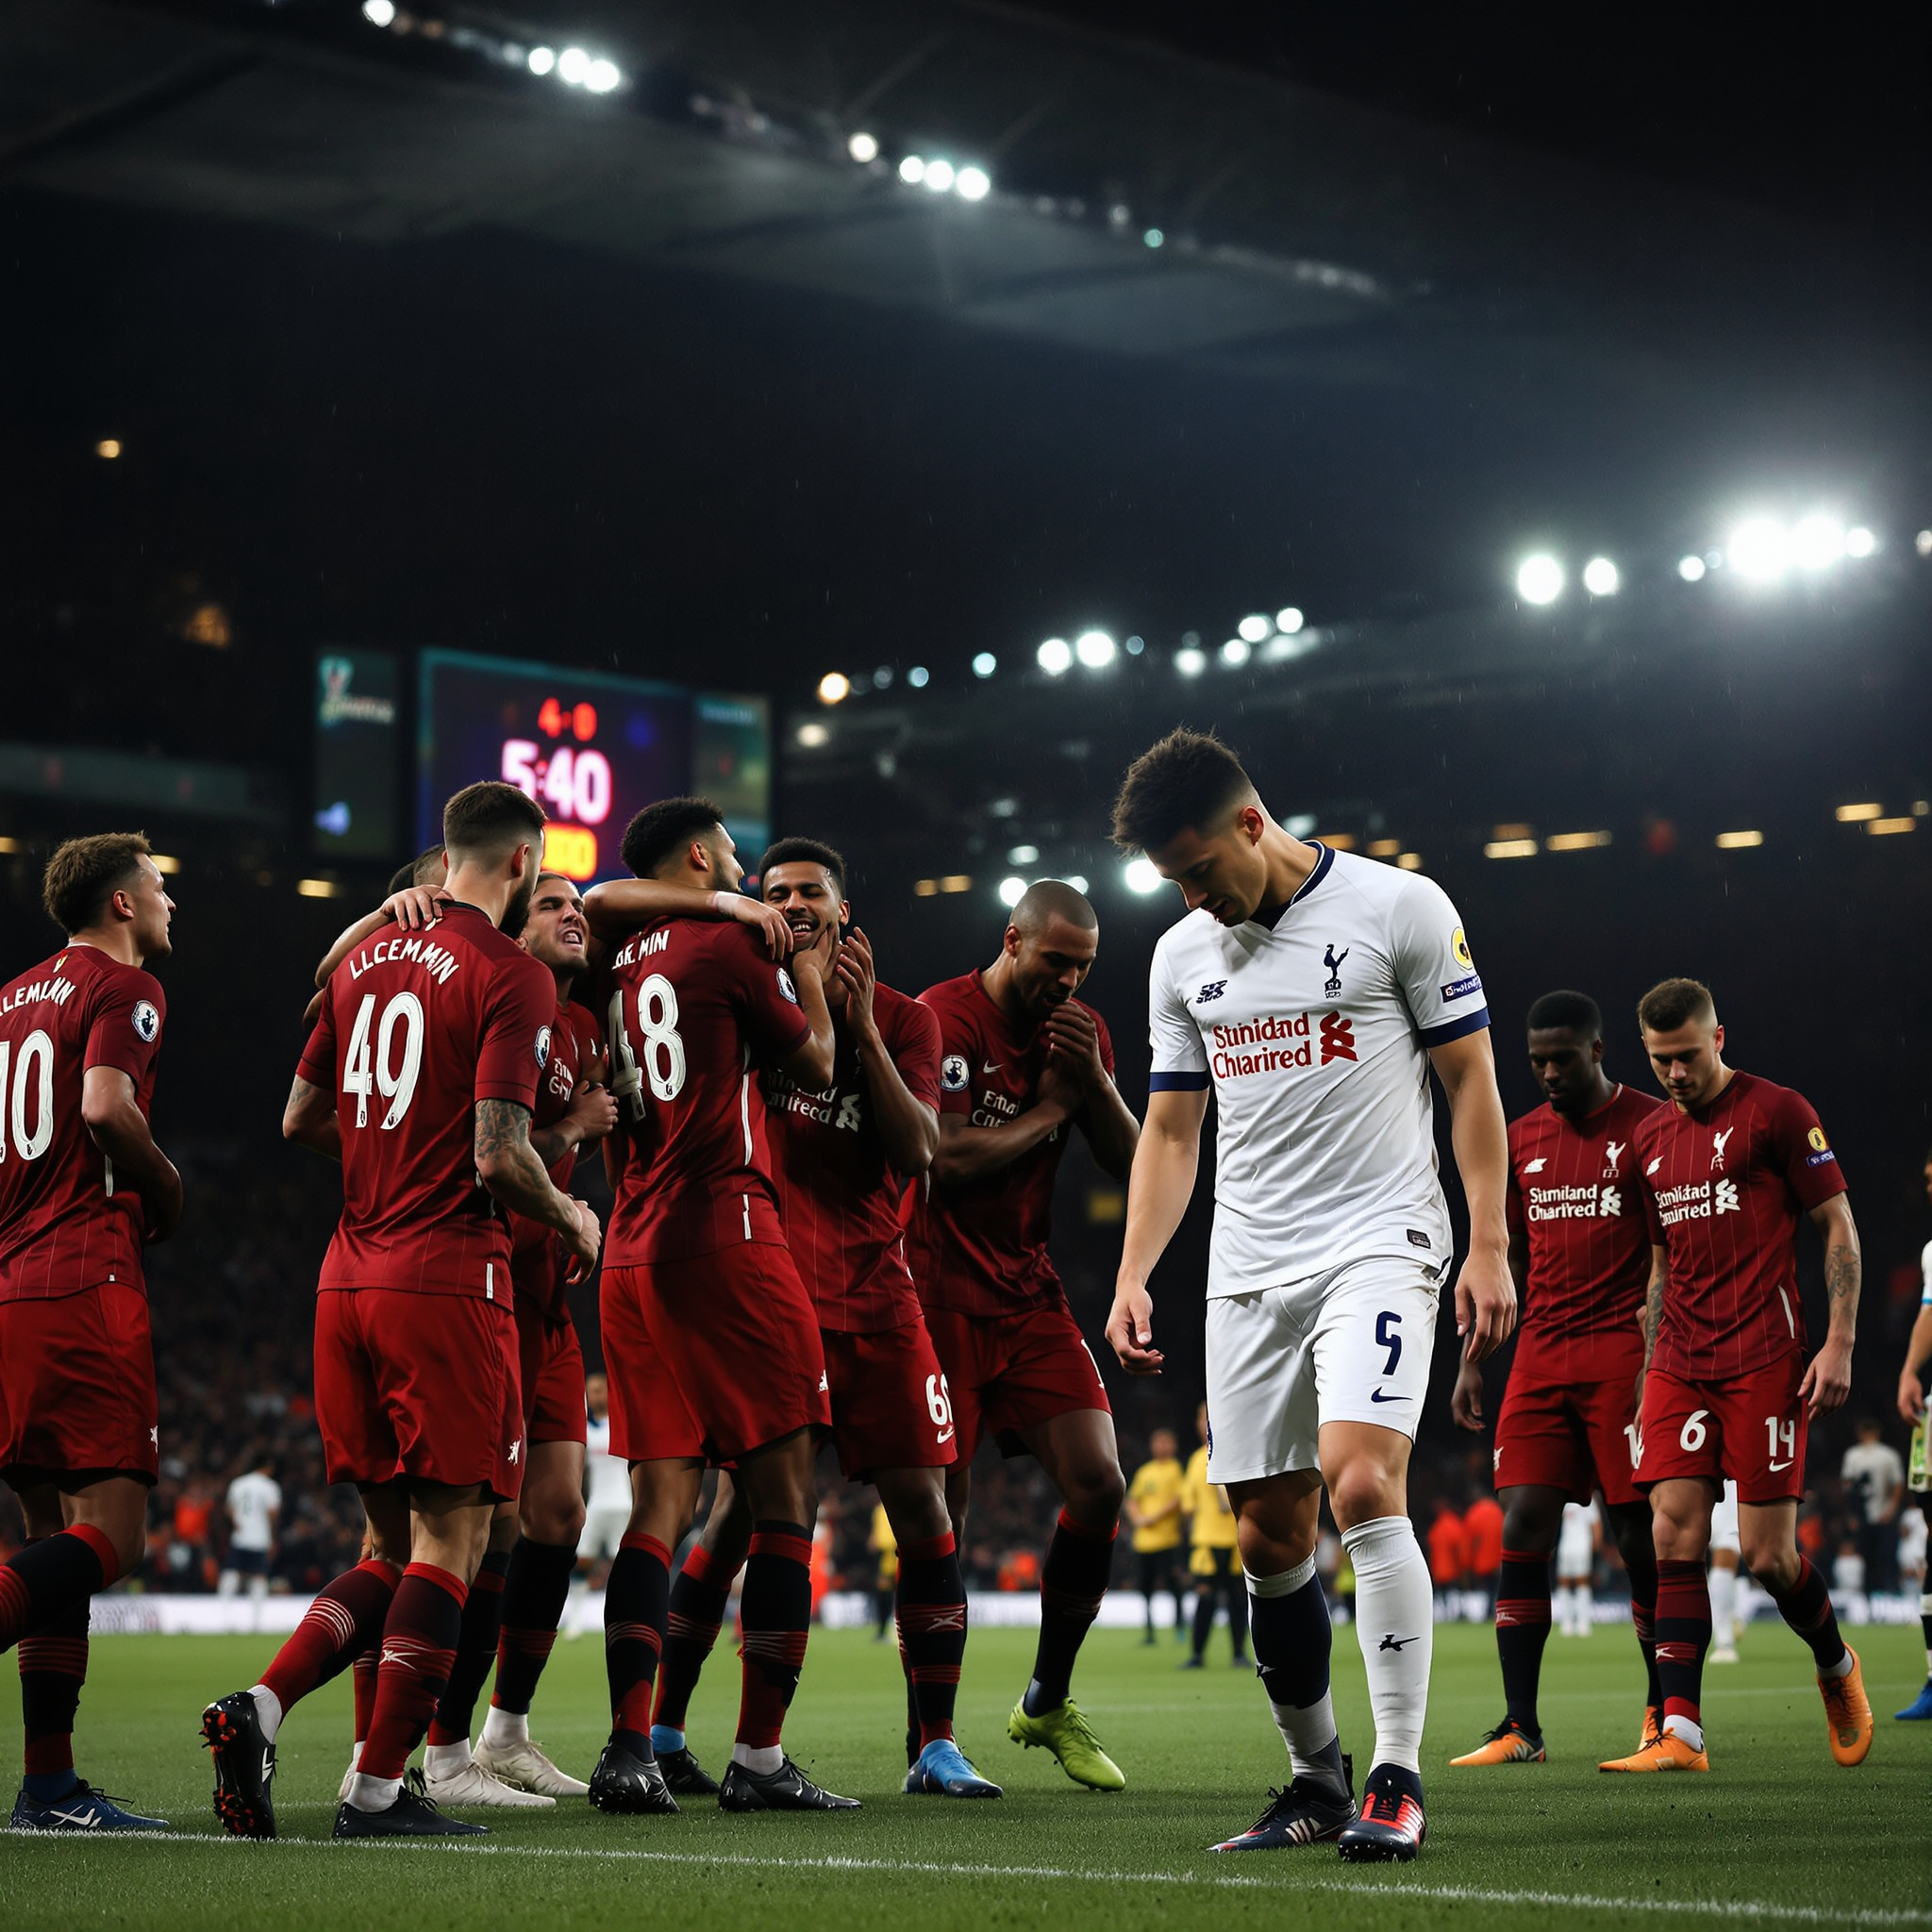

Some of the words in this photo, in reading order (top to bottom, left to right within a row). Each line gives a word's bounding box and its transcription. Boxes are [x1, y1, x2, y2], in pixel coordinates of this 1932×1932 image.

[342, 991, 425, 1130] 49
[608, 973, 687, 1123] 48
[1679, 1409, 1710, 1452] 6
[1764, 1416, 1795, 1458] 14
